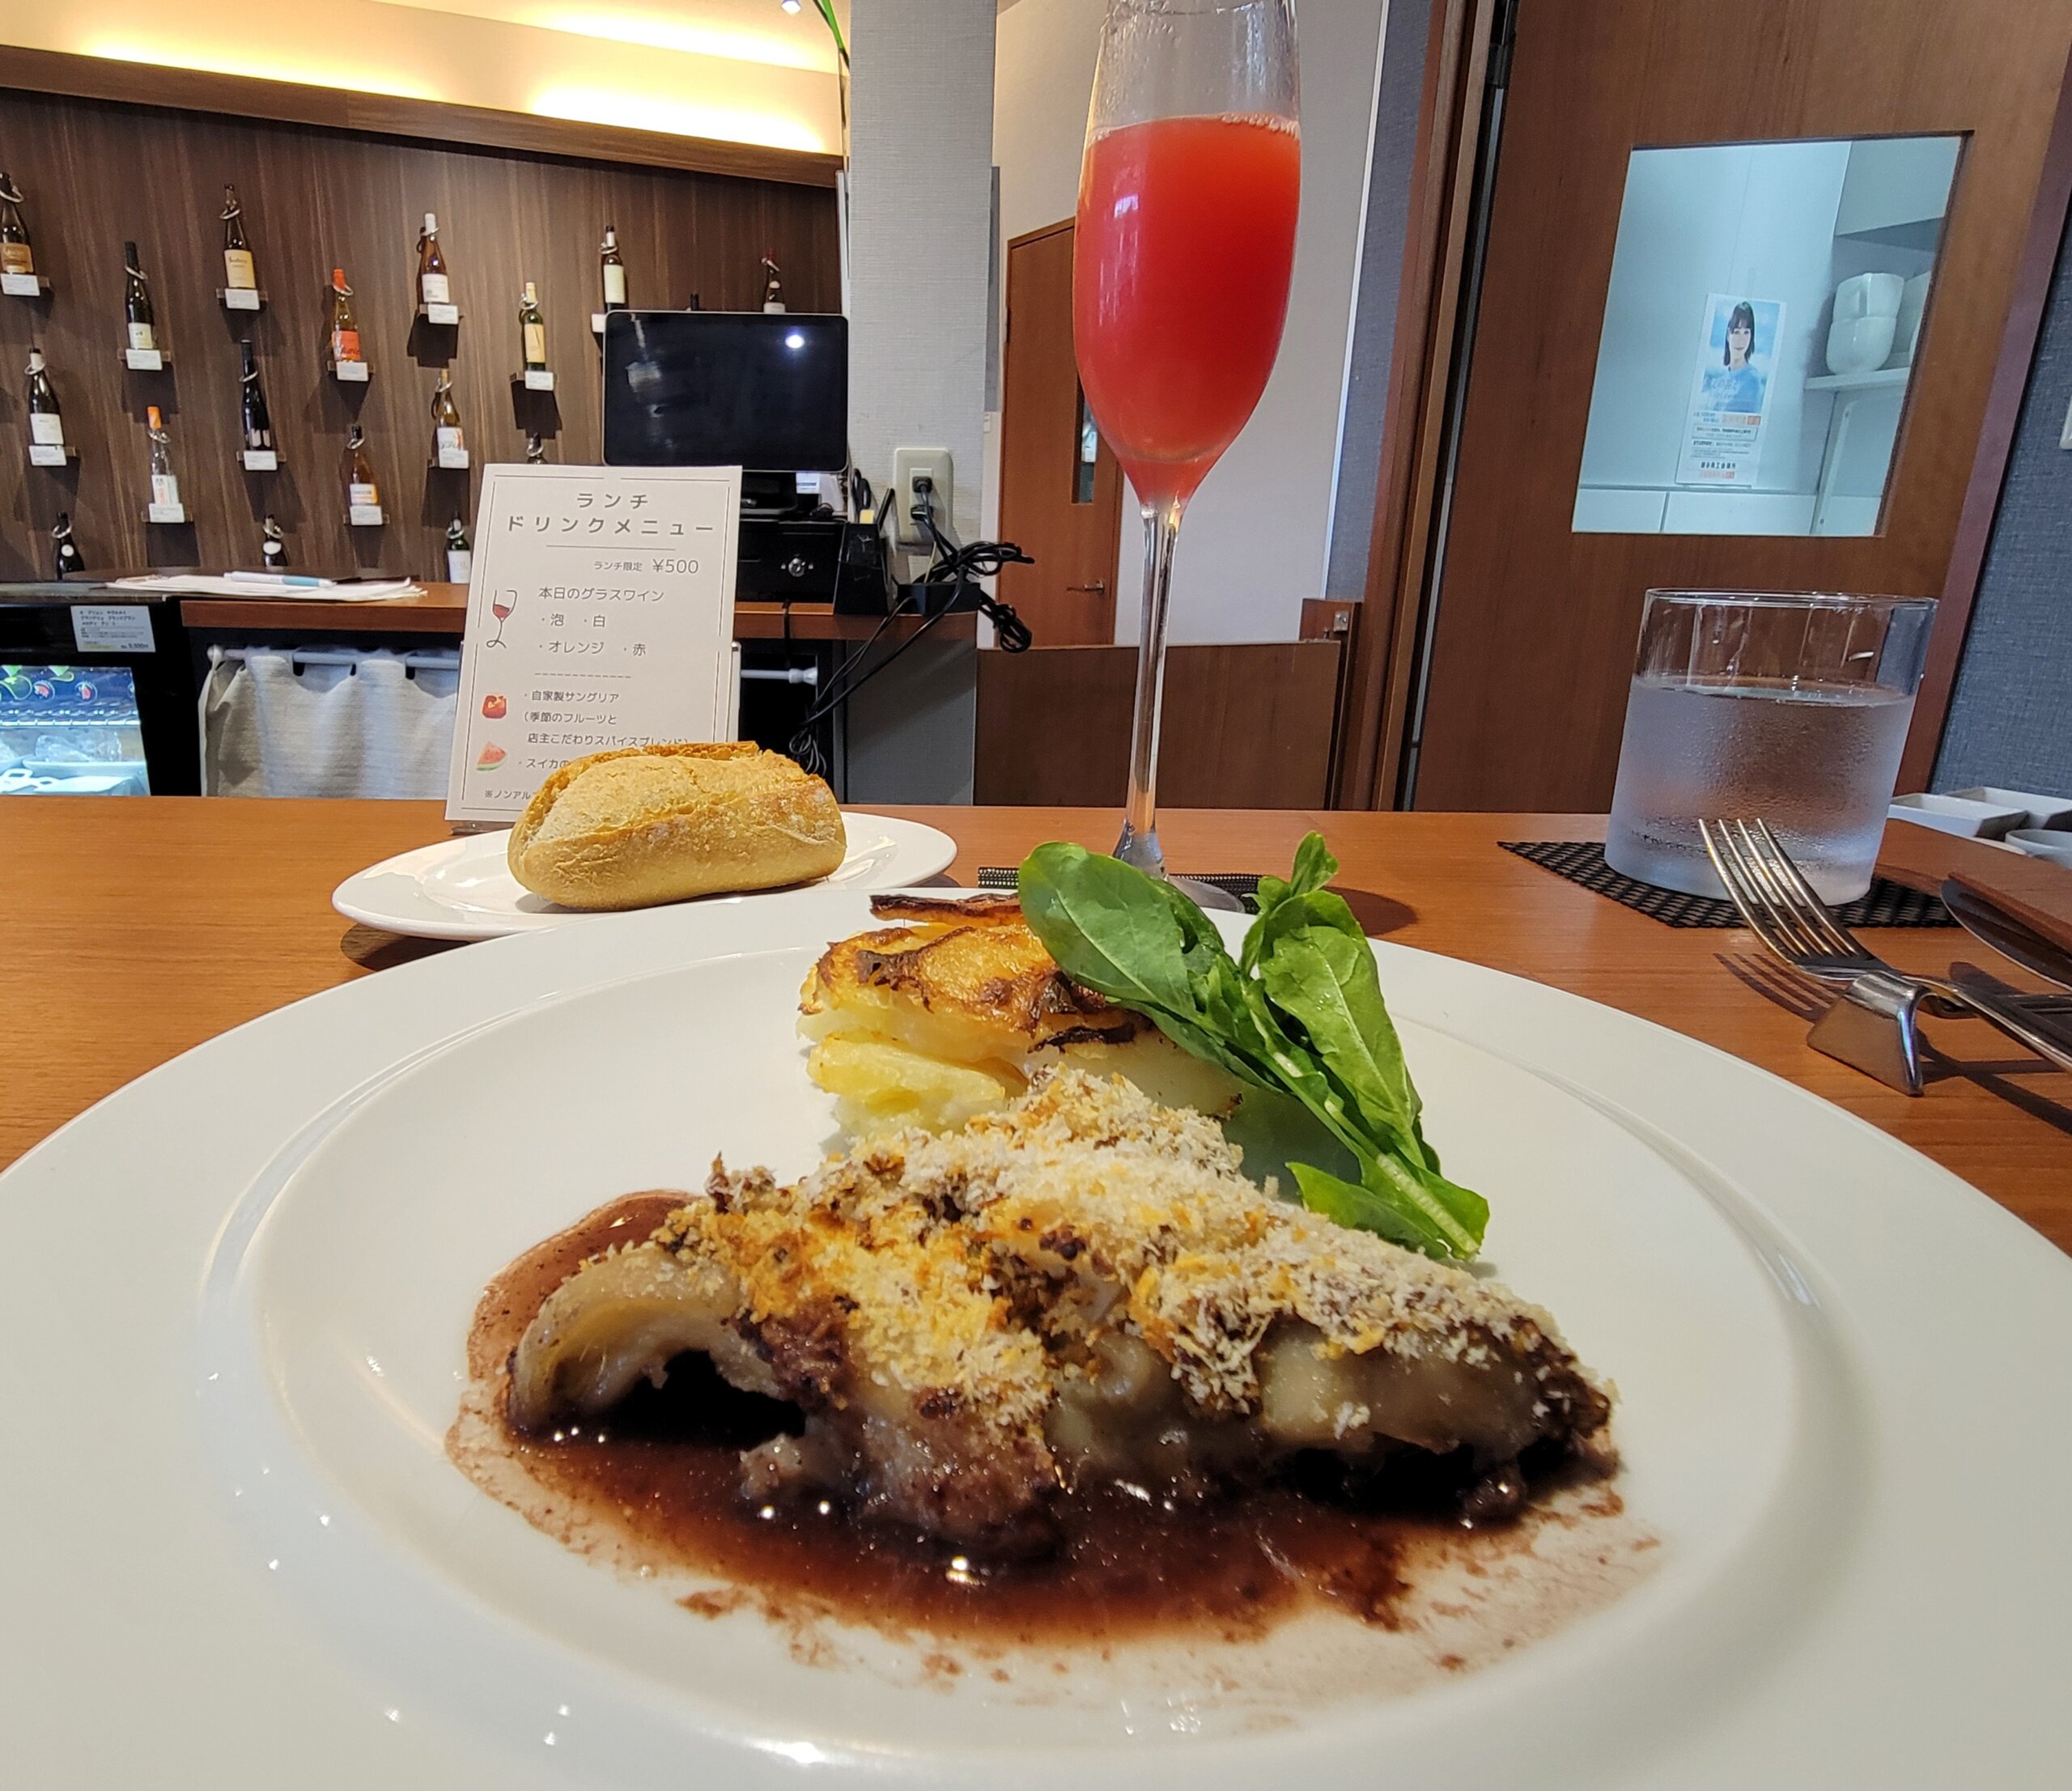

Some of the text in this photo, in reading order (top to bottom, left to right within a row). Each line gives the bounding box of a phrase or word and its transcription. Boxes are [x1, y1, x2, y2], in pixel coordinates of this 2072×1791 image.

[576, 492, 649, 510] ランチ
[507, 516, 714, 536] ドリンクメニュー
[593, 558, 699, 574] ランチ限定 ¥500
[538, 586, 664, 603] 本日のグラスワイン
[485, 790, 535, 800] ※ノンアル
